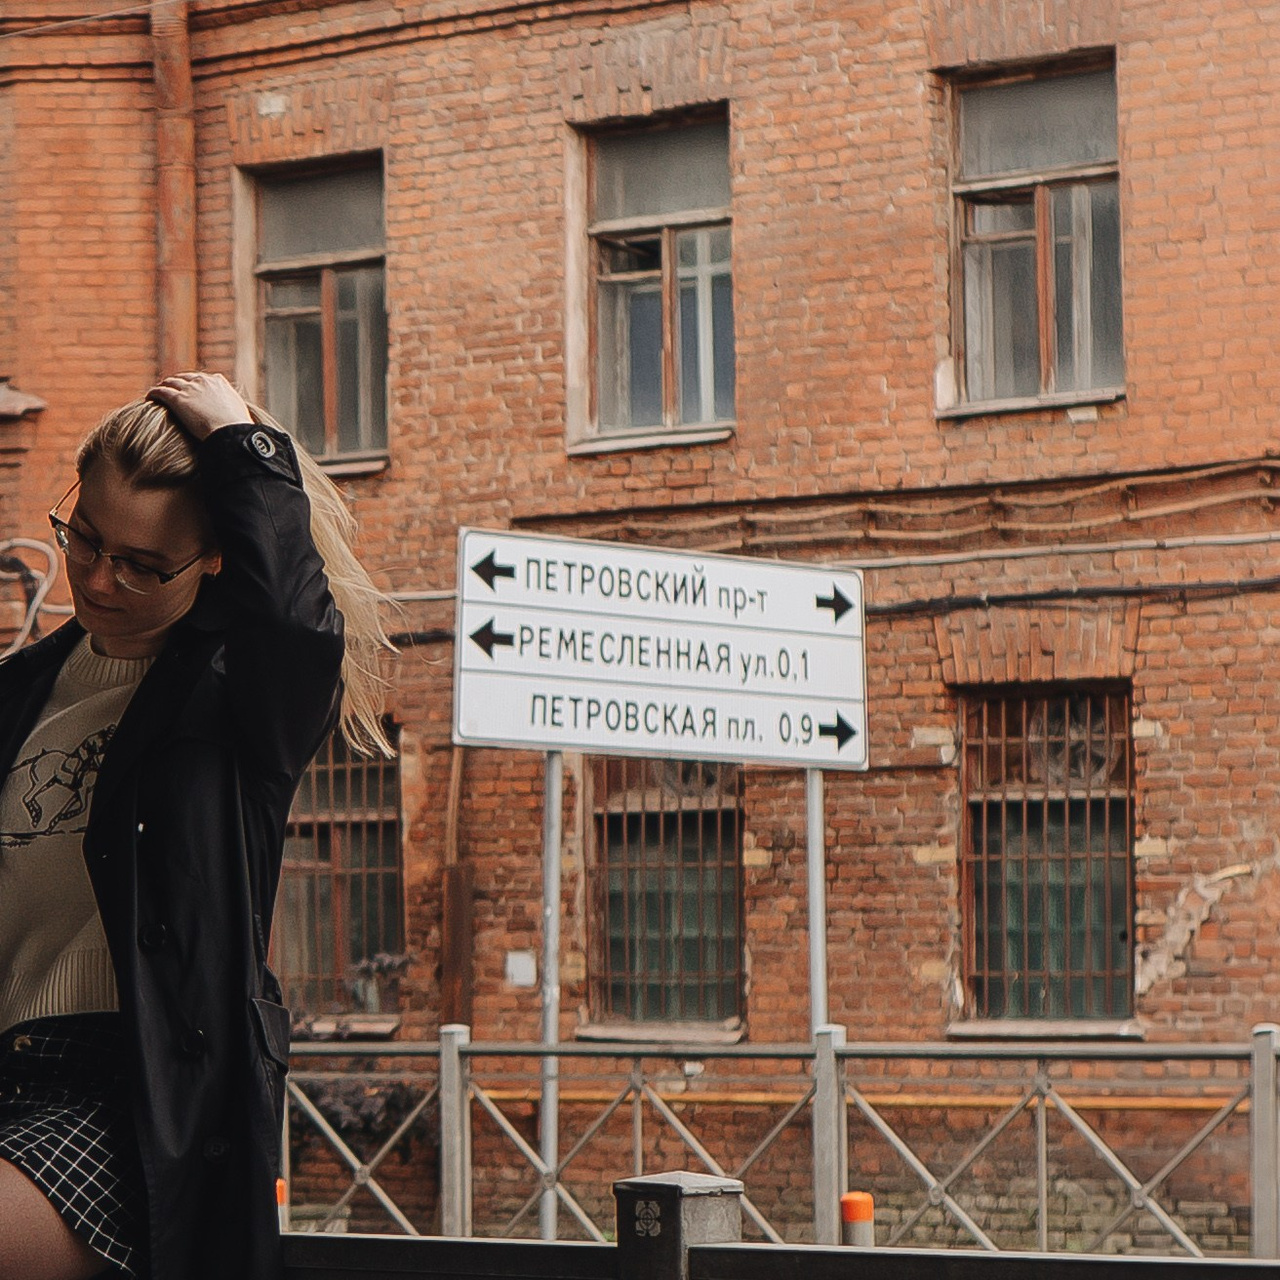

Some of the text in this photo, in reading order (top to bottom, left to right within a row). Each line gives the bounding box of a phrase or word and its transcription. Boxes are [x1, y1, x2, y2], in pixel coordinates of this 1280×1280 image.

[526, 557, 767, 619] ПЕТРОВСКИЙ пр-т
[520, 625, 730, 674] РЕМЕСЛЕННАЯ
[531, 694, 812, 747] ПЕТРОВСКАЯ пл. 0,9
